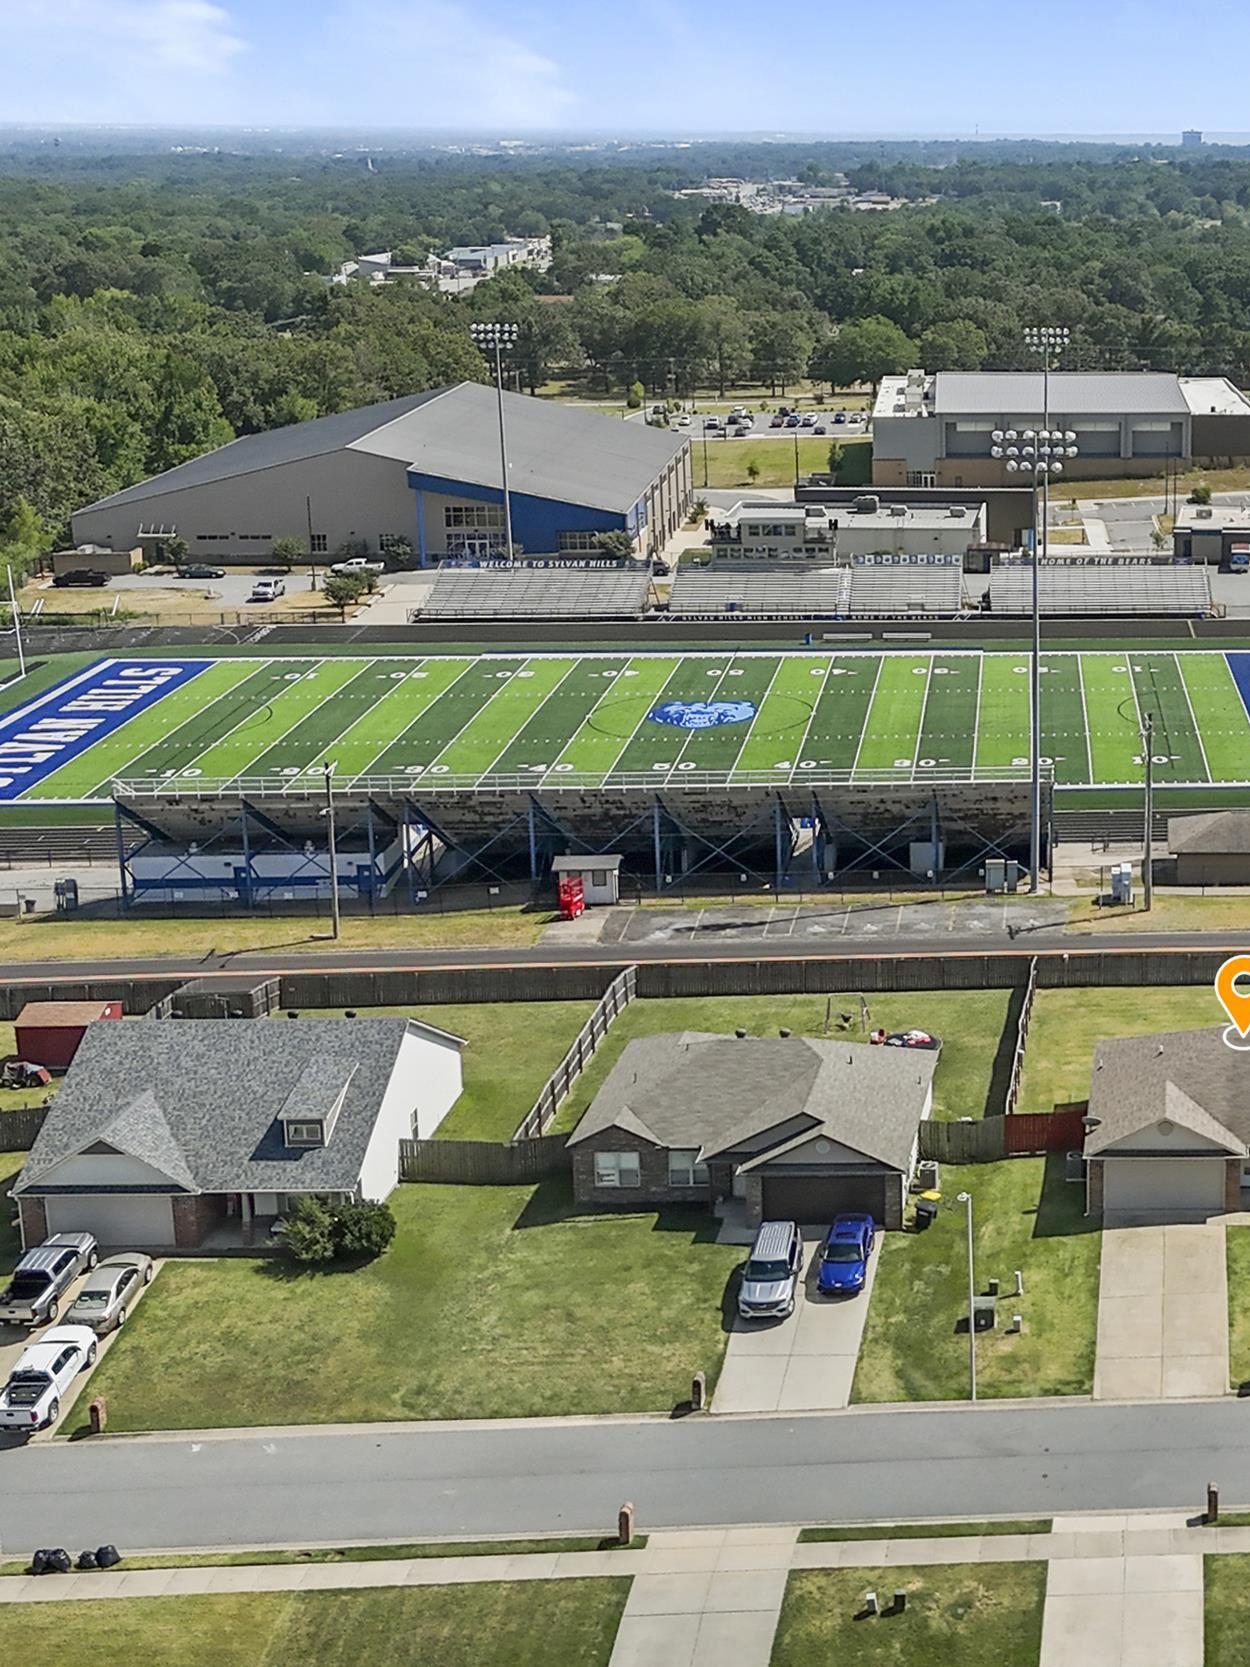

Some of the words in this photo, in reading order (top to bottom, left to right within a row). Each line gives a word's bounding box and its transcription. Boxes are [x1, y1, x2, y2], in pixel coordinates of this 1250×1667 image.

[480, 560, 528, 569] WELCOME
[532, 560, 545, 568] TO
[548, 560, 586, 568] SYLVAN
[589, 559, 618, 568] HILLS
[1040, 558, 1071, 566] HOME
[1076, 558, 1090, 566] OF
[1094, 557, 1113, 566] THE
[1118, 557, 1152, 565] BEARS
[0, 717, 107, 788] LVAN
[58, 667, 184, 712] HILLS
[159, 768, 203, 778] 10
